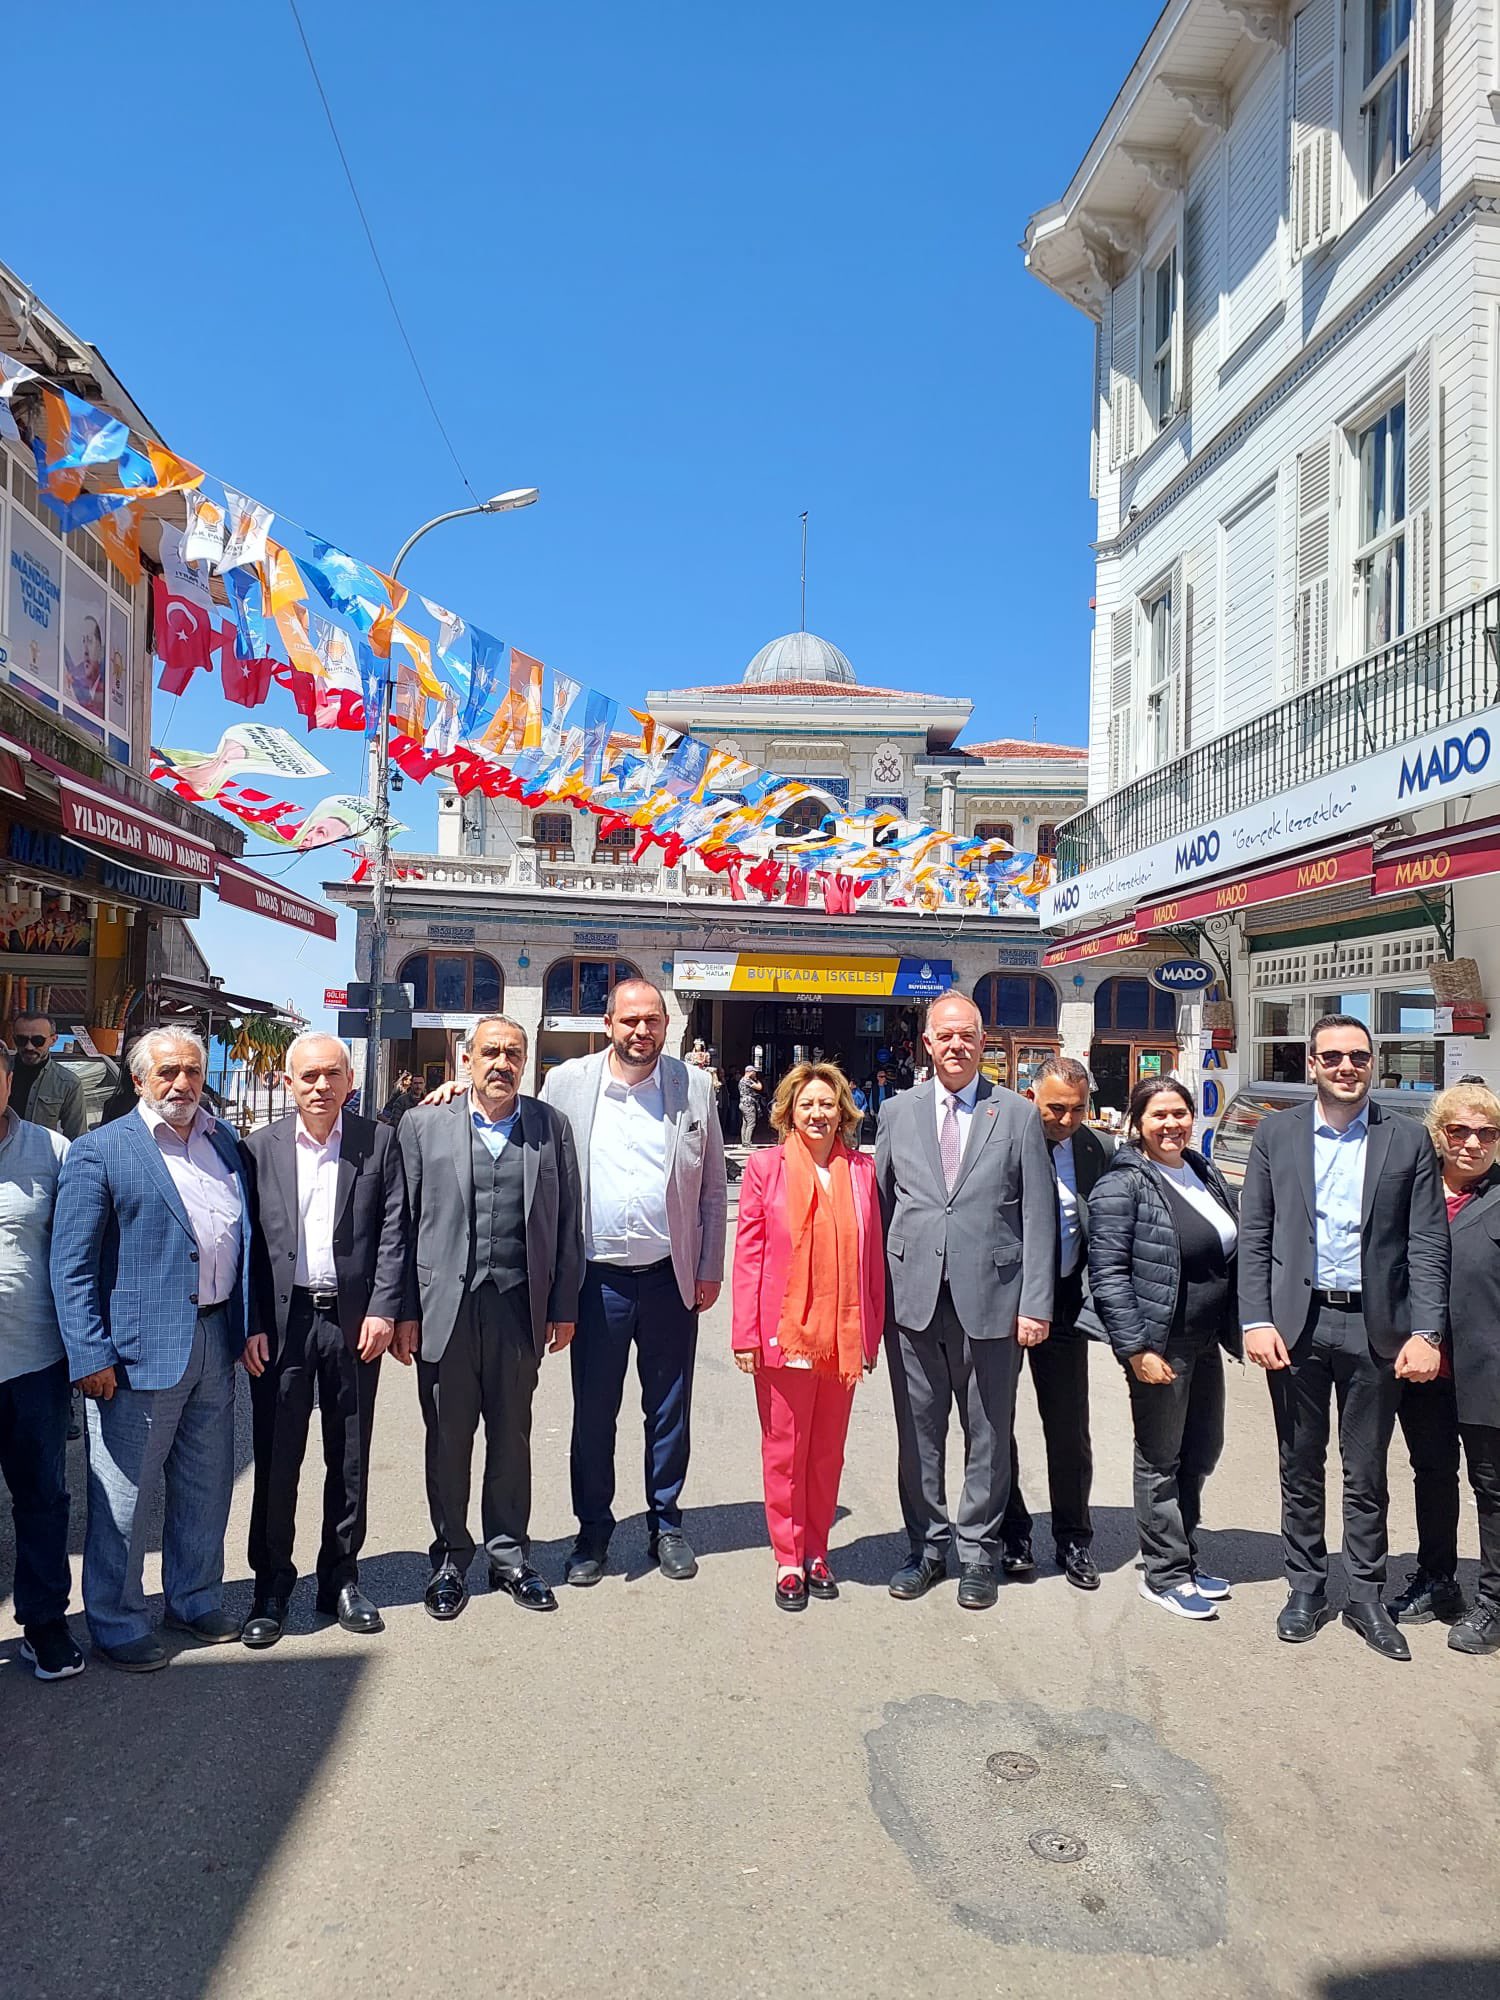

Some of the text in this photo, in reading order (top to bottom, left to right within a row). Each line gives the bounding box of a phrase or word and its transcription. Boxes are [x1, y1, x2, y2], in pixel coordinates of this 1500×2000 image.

[20, 575, 51, 614] YOLDA
[1398, 727, 1491, 800] MADO
[72, 803, 211, 875] YILDIZLAR MİNİ MARKET
[1175, 829, 1220, 875] MADO
[1297, 857, 1338, 889] MADO
[1395, 851, 1451, 887] MADO
[255, 889, 279, 917] MARAŞ
[1053, 884, 1080, 916] MADO
[1215, 882, 1247, 909] MADO
[1153, 902, 1178, 925] MADO
[1080, 939, 1100, 955] MADO
[1116, 929, 1138, 946] MADO
[747, 965, 885, 983] BÜYÜKADA İSKELESİ
[1162, 966, 1207, 981] MADO
